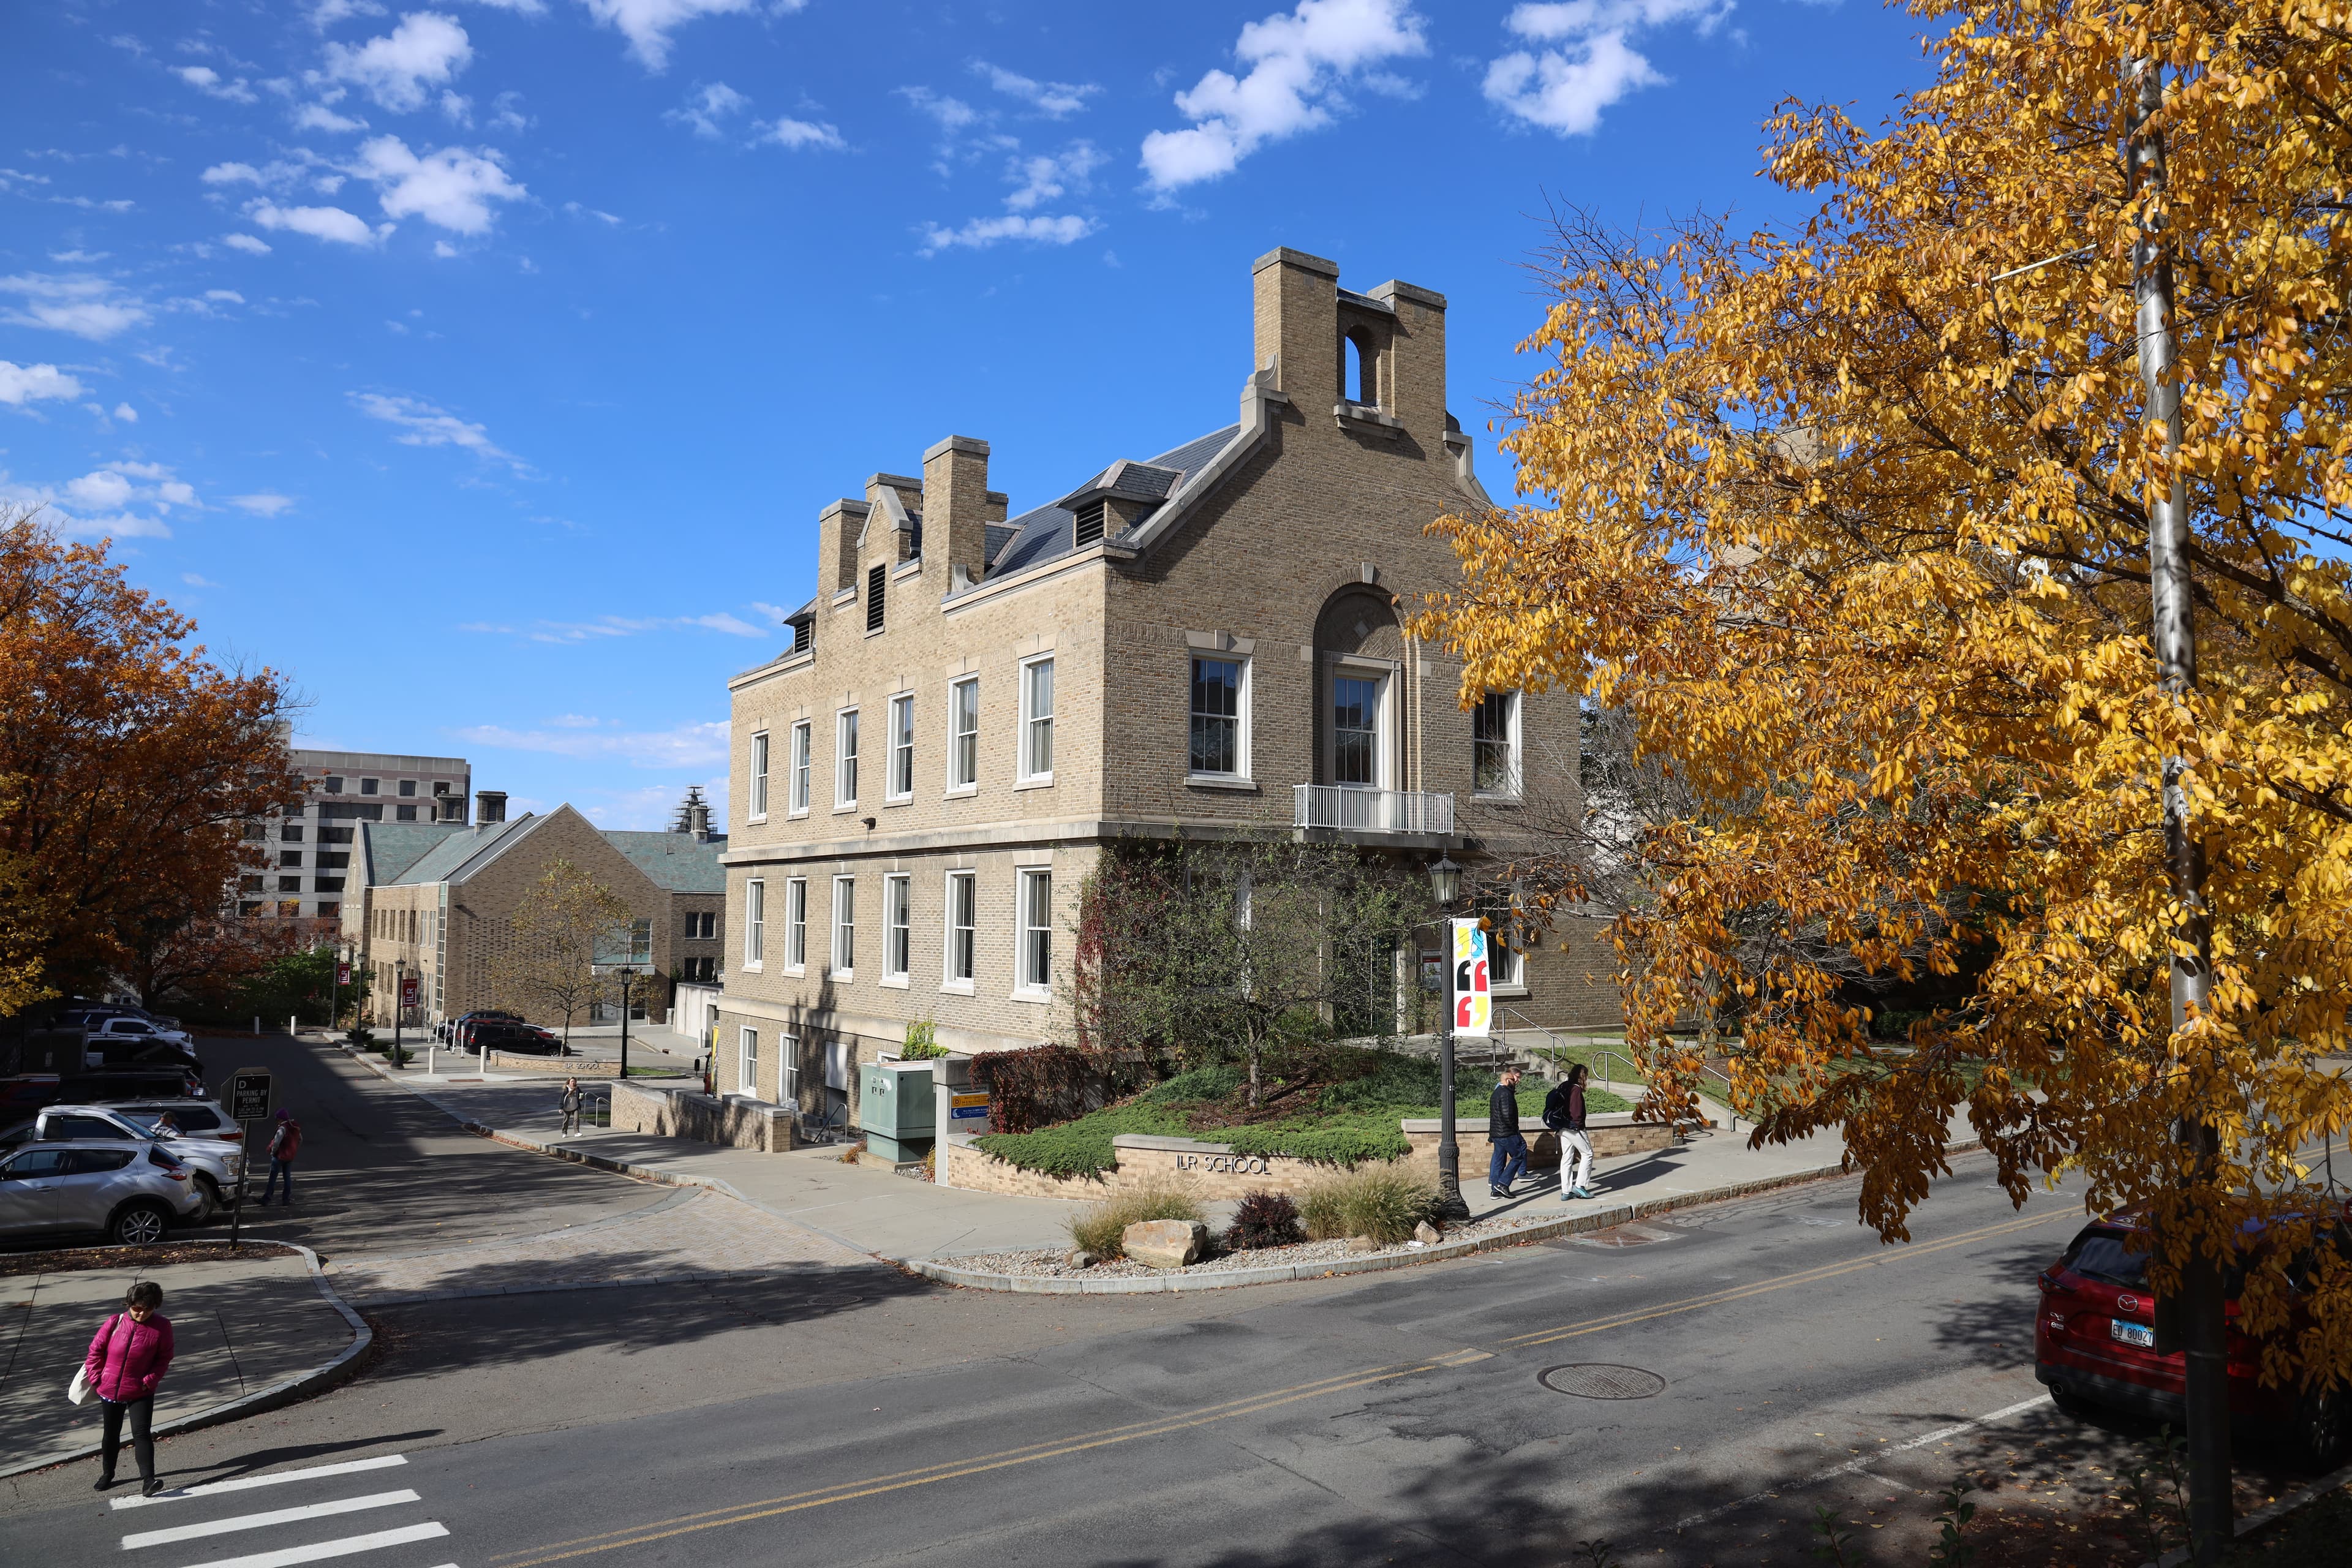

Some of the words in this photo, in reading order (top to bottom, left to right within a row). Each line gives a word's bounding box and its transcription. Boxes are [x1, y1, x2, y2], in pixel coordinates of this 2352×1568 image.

[239, 1080, 247, 1089] D
[1176, 1154, 1198, 1172] ILR
[1204, 1155, 1271, 1175] SCHOOL
[2113, 1324, 2122, 1336] ED
[2127, 1327, 2152, 1343] 80027
